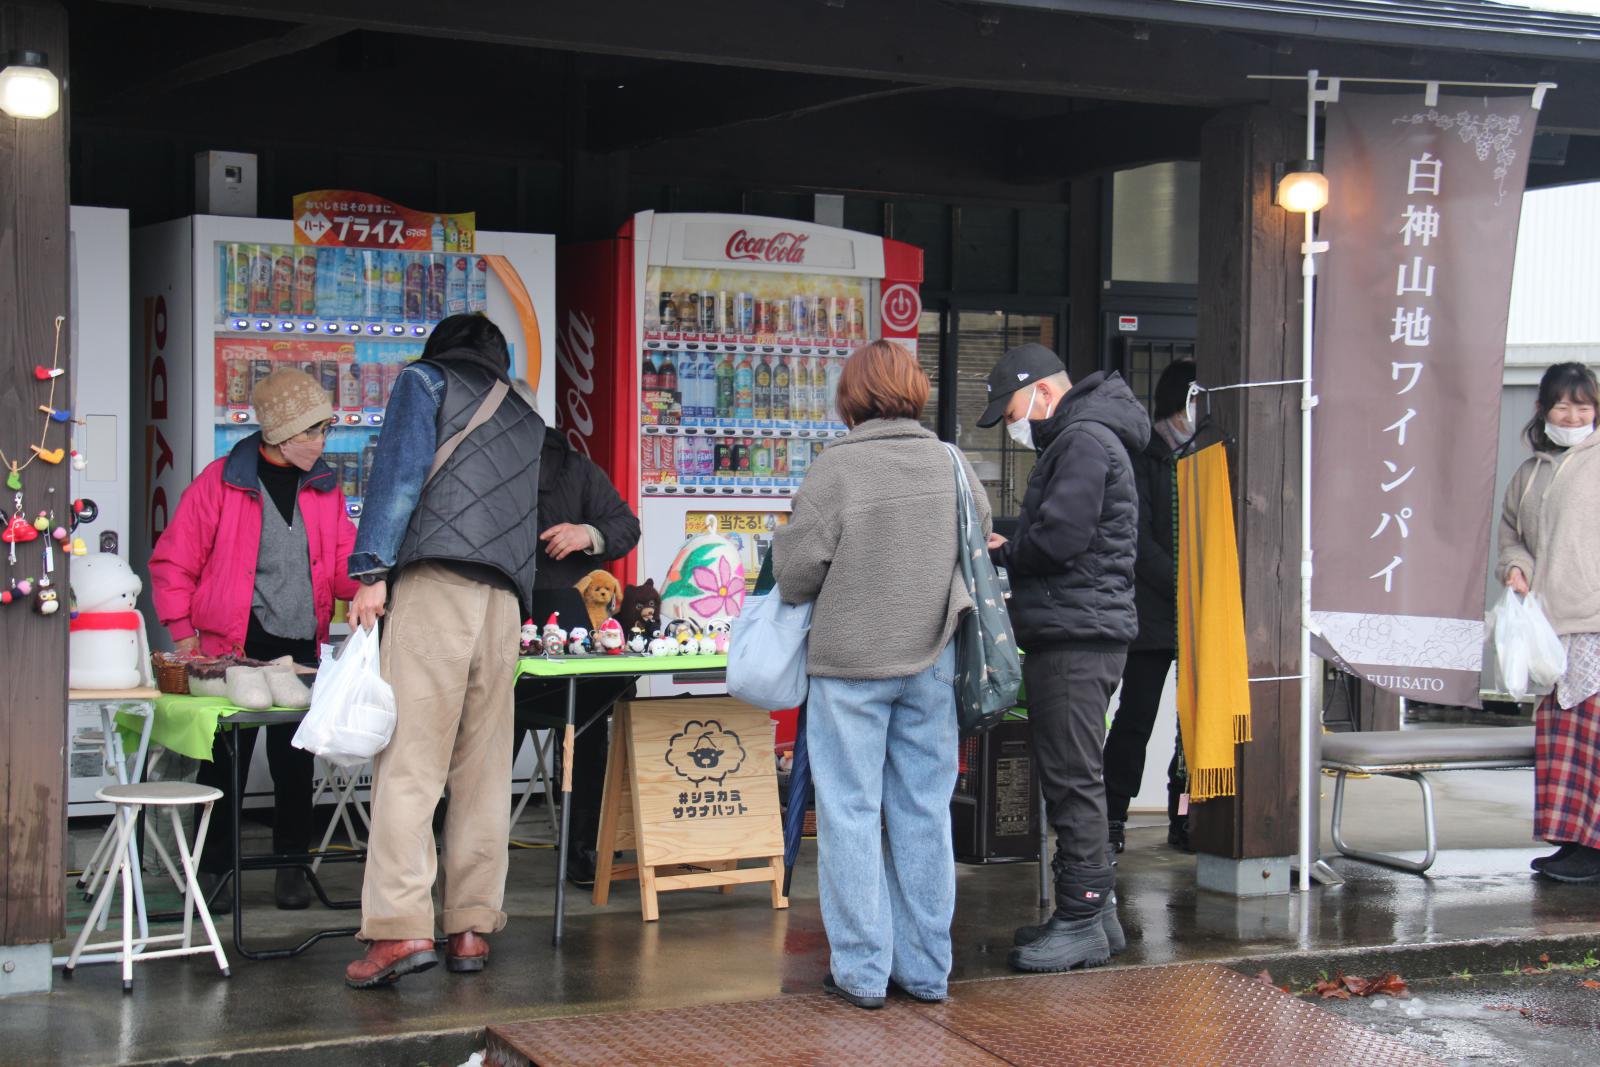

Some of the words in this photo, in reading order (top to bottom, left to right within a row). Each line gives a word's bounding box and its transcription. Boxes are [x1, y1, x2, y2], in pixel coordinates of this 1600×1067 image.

[305, 201, 396, 215] おいしさはそのままに。
[304, 219, 325, 232] ハート
[333, 216, 406, 244] プライス
[725, 229, 810, 263] Coca-Cola
[1368, 151, 1443, 593] 白神山地ワインパイ
[721, 514, 762, 530] 当たる!
[1366, 673, 1444, 692] FUJISATO
[678, 789, 742, 805] #シラカミ
[672, 803, 748, 819] サウナハット
